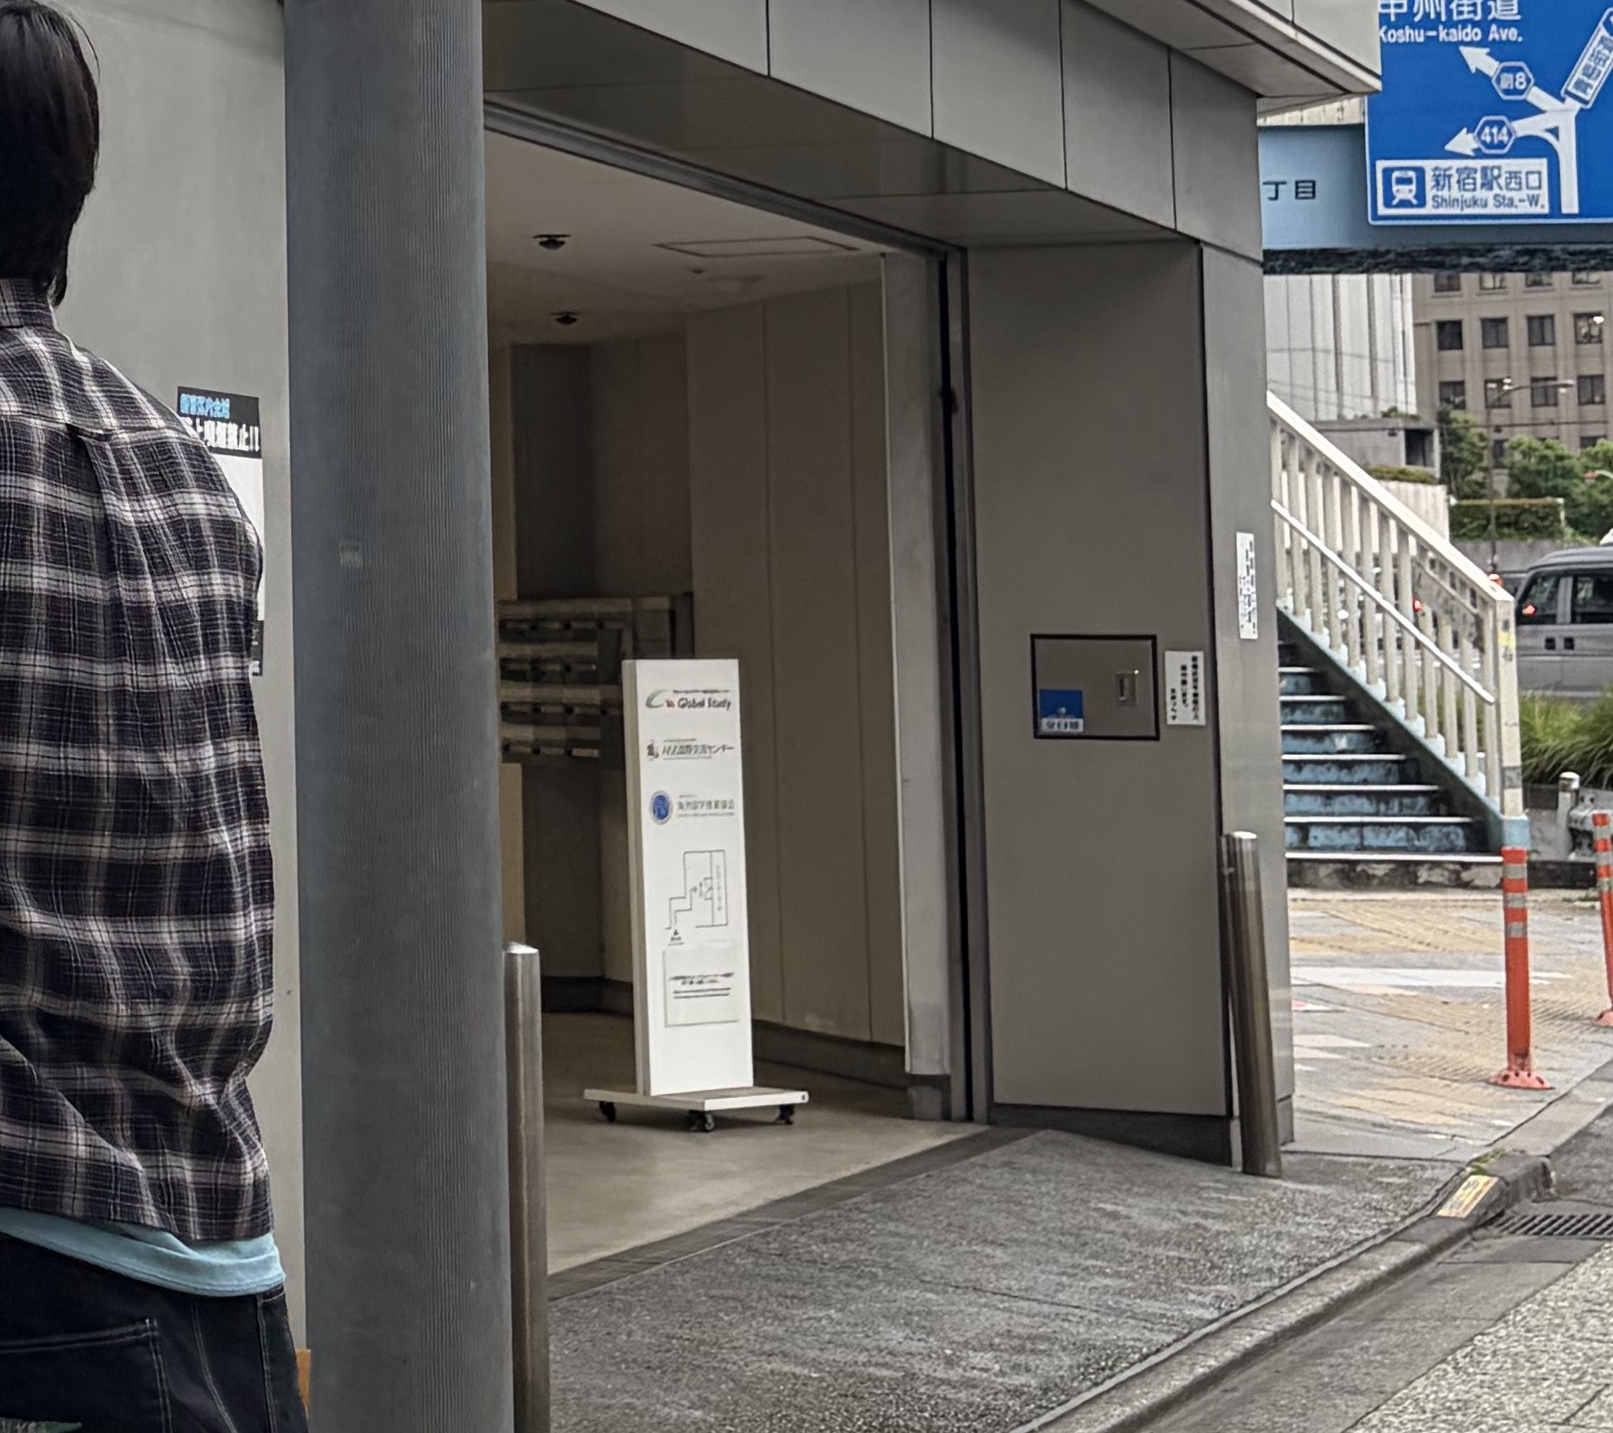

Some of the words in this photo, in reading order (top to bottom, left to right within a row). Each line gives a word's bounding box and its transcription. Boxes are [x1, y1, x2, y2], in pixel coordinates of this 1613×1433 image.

[1377, 24, 1482, 44] Koshu-kaido
[1488, 26, 1523, 43] Ave.
[1480, 126, 1508, 144] 414
[1431, 166, 1543, 192] 新宿駅西口
[1431, 194, 1488, 211] Shinjuku
